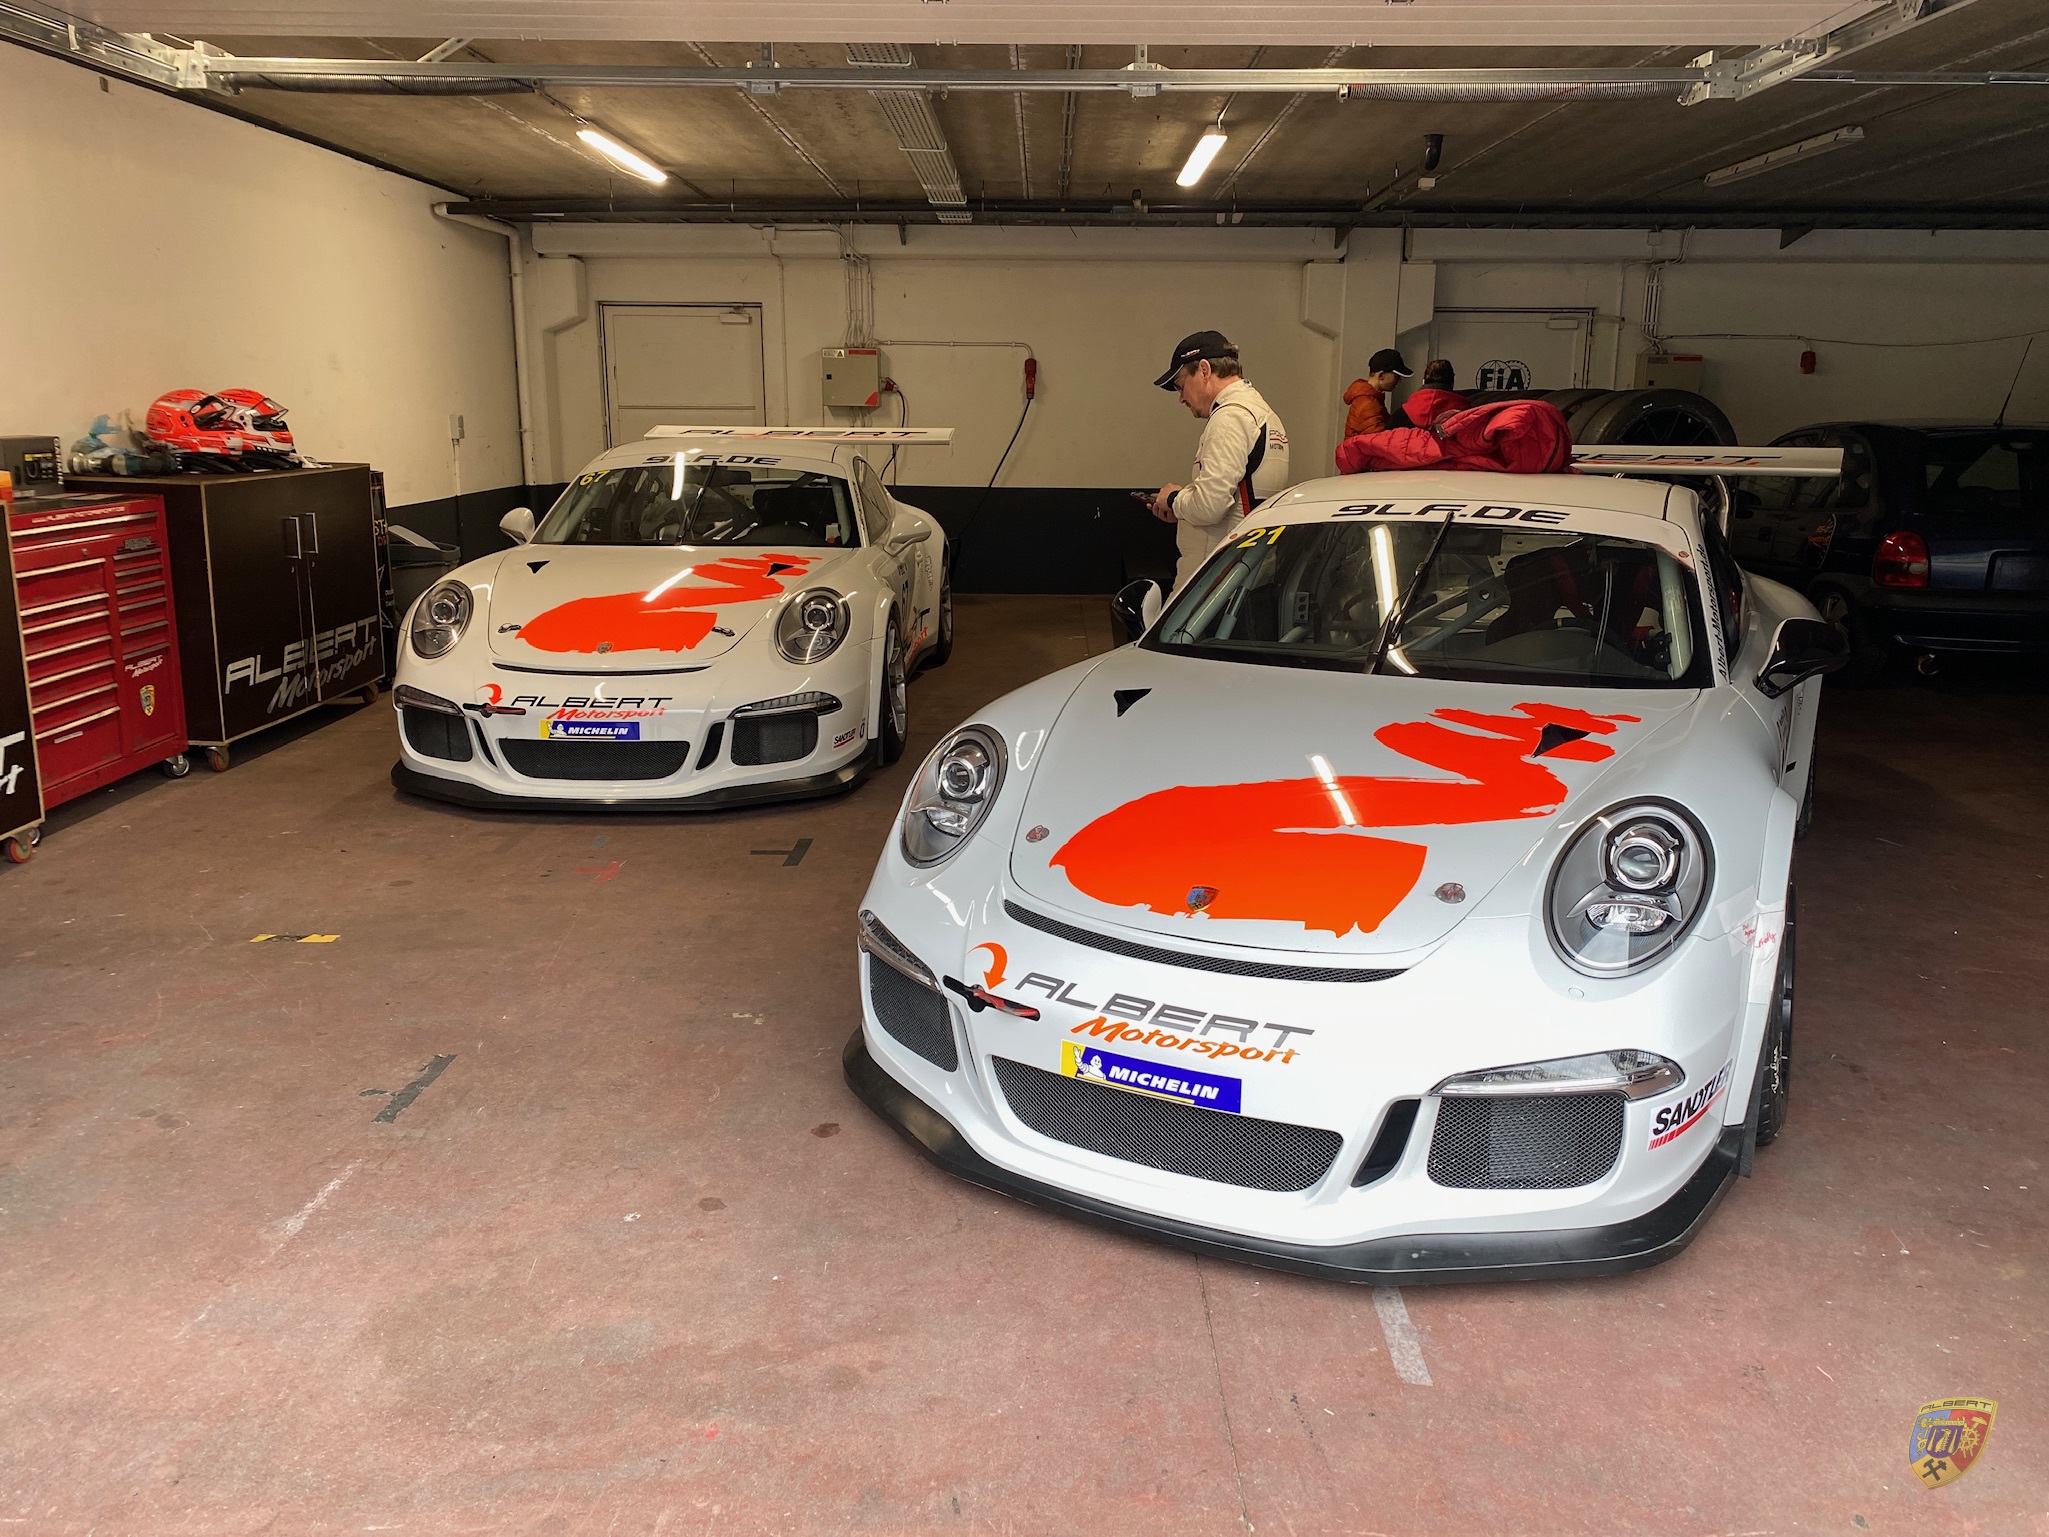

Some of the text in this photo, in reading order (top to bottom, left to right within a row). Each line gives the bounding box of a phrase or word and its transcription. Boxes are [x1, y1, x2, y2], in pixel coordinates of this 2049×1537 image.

[579, 470, 611, 486] 67
[1331, 503, 1572, 525] 9LF.DE
[1236, 525, 1287, 549] 21
[1696, 543, 1729, 684] Albert-Motorsport.de
[225, 614, 378, 695] ALBERT
[266, 635, 377, 715] Motorsport
[510, 696, 673, 709] ALBERT
[546, 707, 668, 721] Motorsport
[567, 726, 629, 736] MICHELIN
[1015, 972, 1315, 1049] ALBERT
[1070, 1015, 1301, 1064] Motorsport
[1108, 1065, 1220, 1100] MICHELIN
